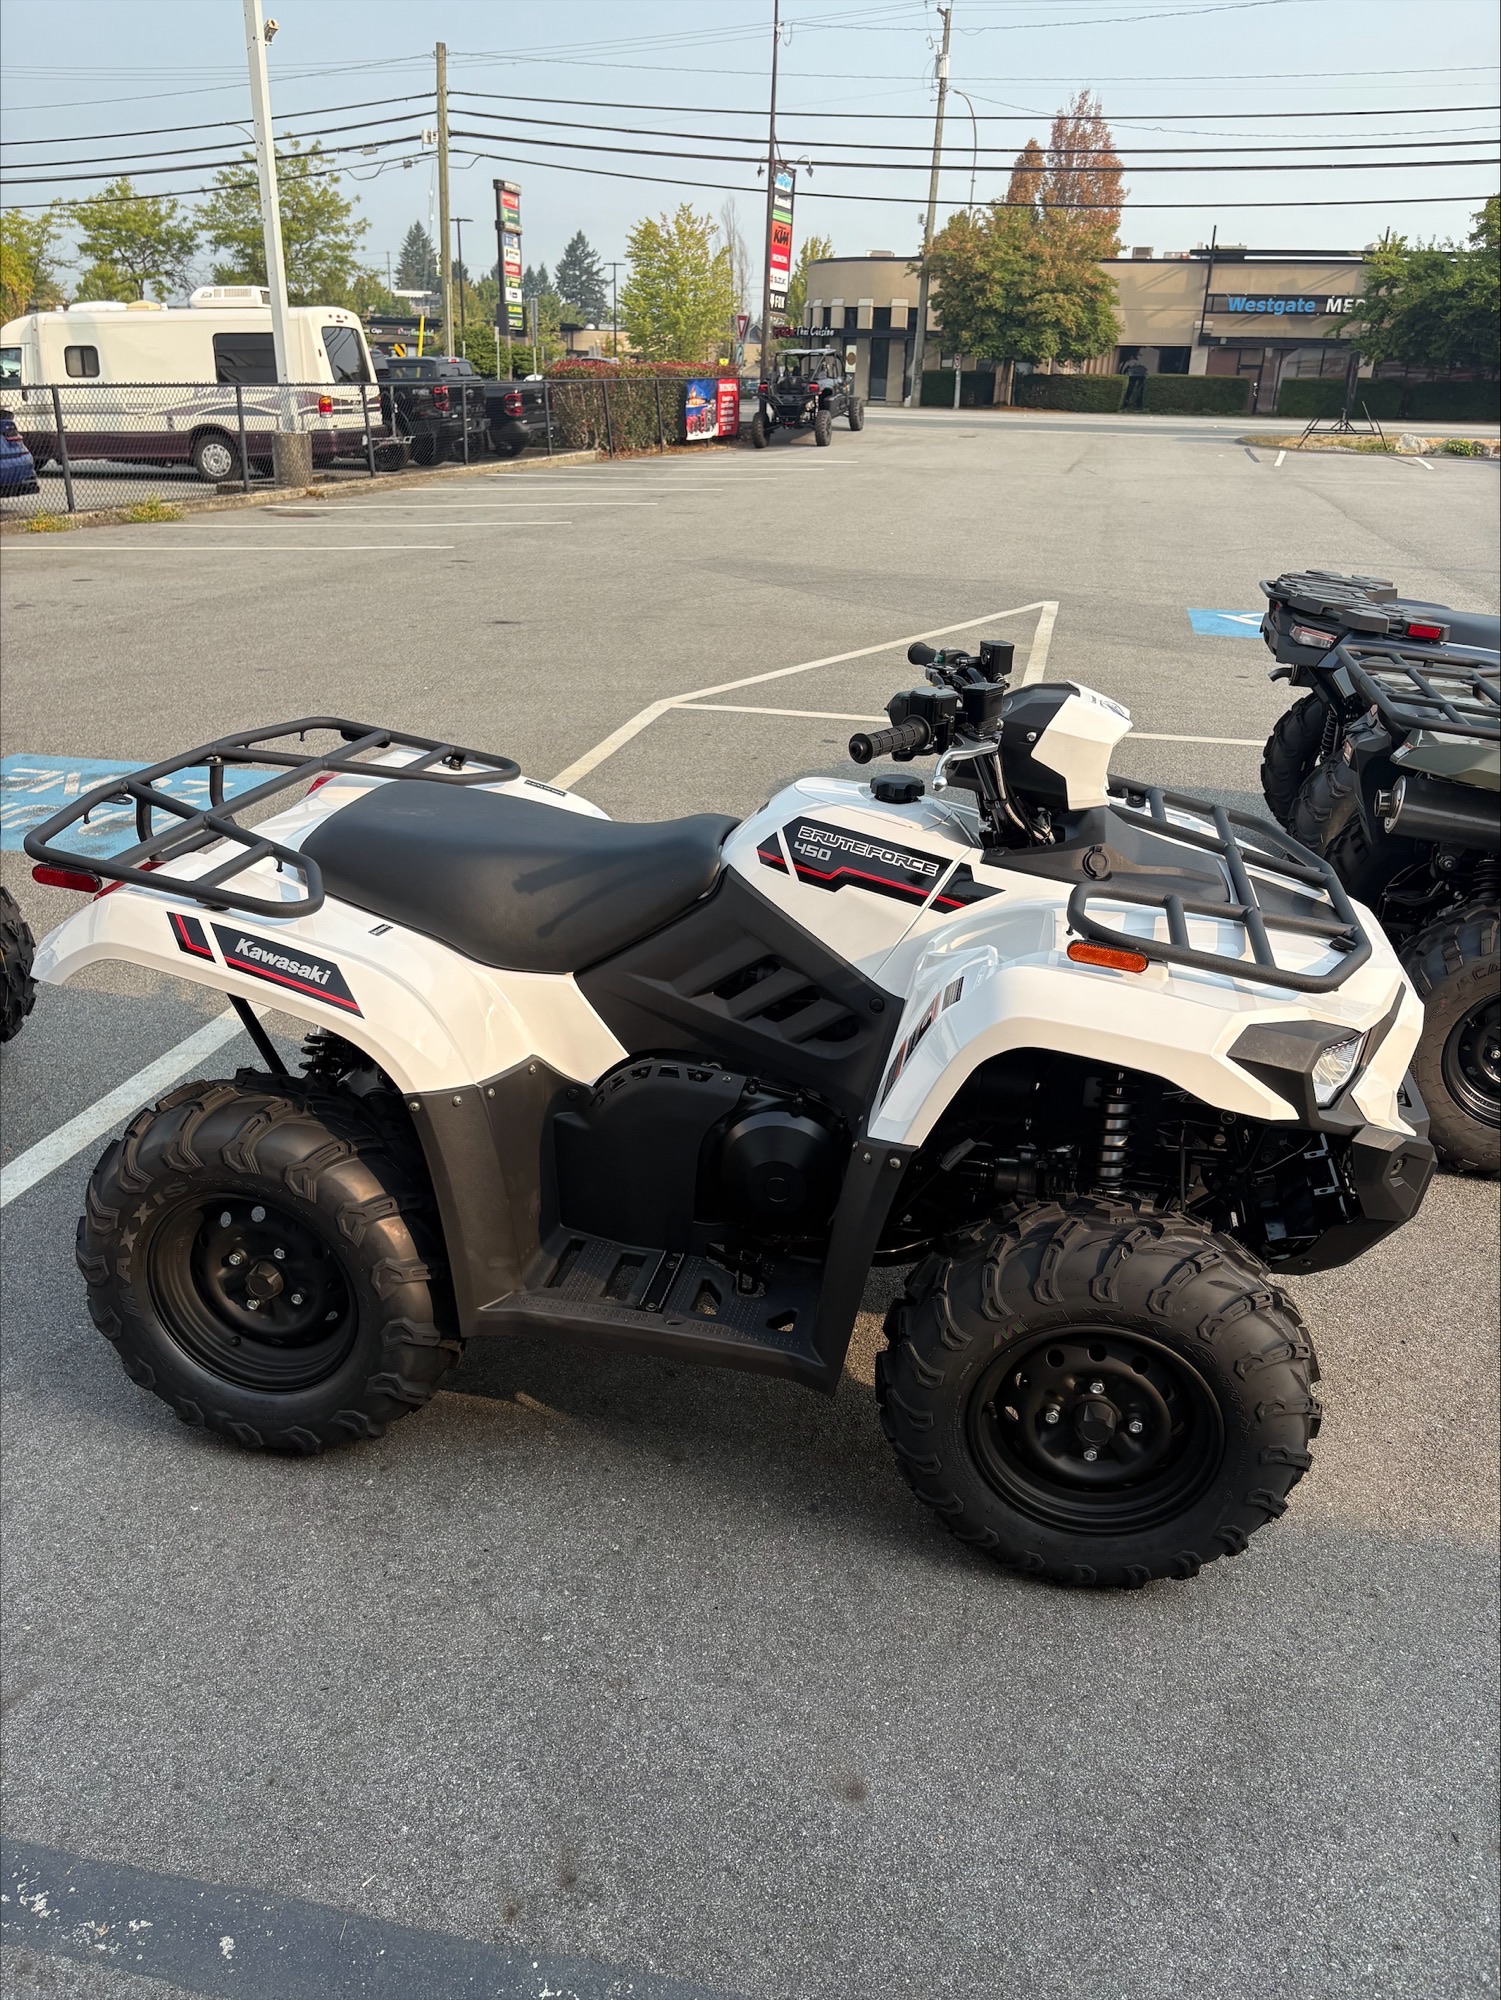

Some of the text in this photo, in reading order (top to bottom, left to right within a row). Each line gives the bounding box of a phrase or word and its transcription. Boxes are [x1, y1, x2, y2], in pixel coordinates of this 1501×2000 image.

[773, 225, 789, 246] KTM
[775, 295, 785, 308] FOX
[1228, 297, 1316, 315] Westgate
[796, 325, 809, 336] Thai
[810, 325, 834, 337] Cuisine
[793, 841, 832, 862] 450
[234, 937, 332, 986] Kawasaki
[116, 1181, 188, 1318] MAXXIS
